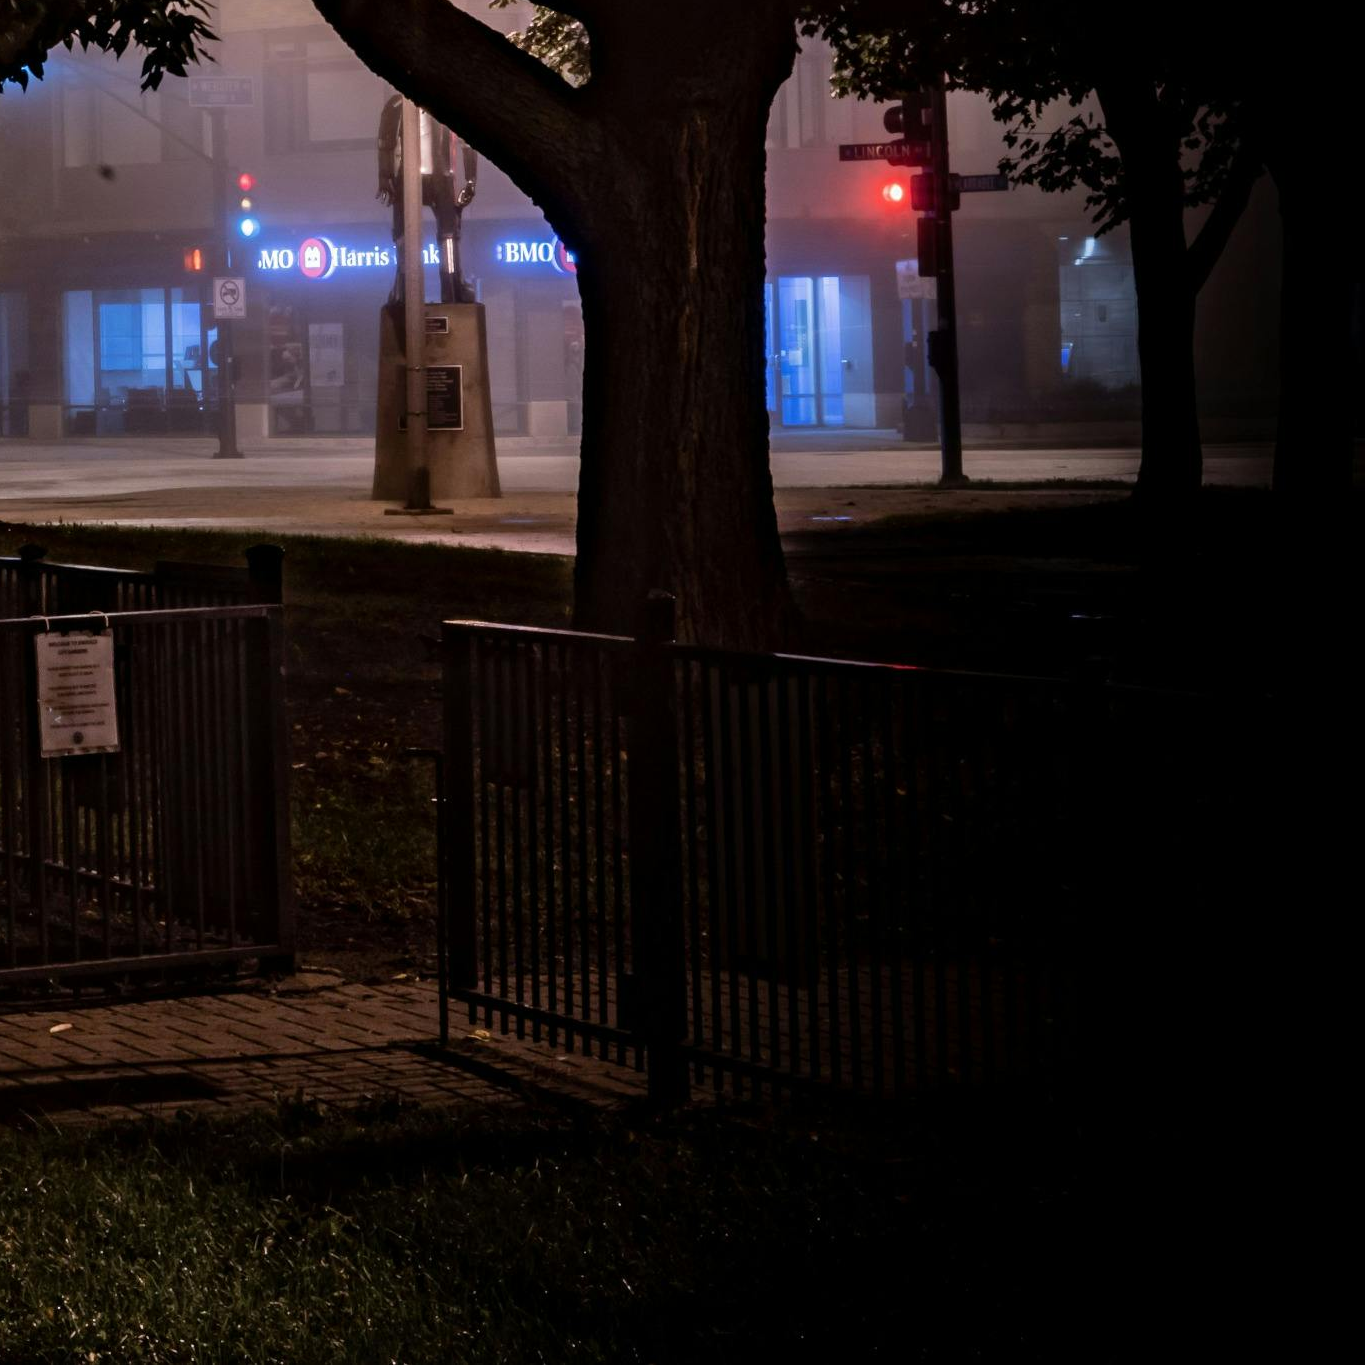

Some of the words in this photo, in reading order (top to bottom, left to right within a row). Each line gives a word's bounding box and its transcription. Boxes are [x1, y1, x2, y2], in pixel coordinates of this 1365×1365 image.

[854, 145, 911, 158] LINCOLN
[259, 250, 294, 269] MO
[331, 246, 389, 267] Harris
[505, 242, 553, 263] BMO
